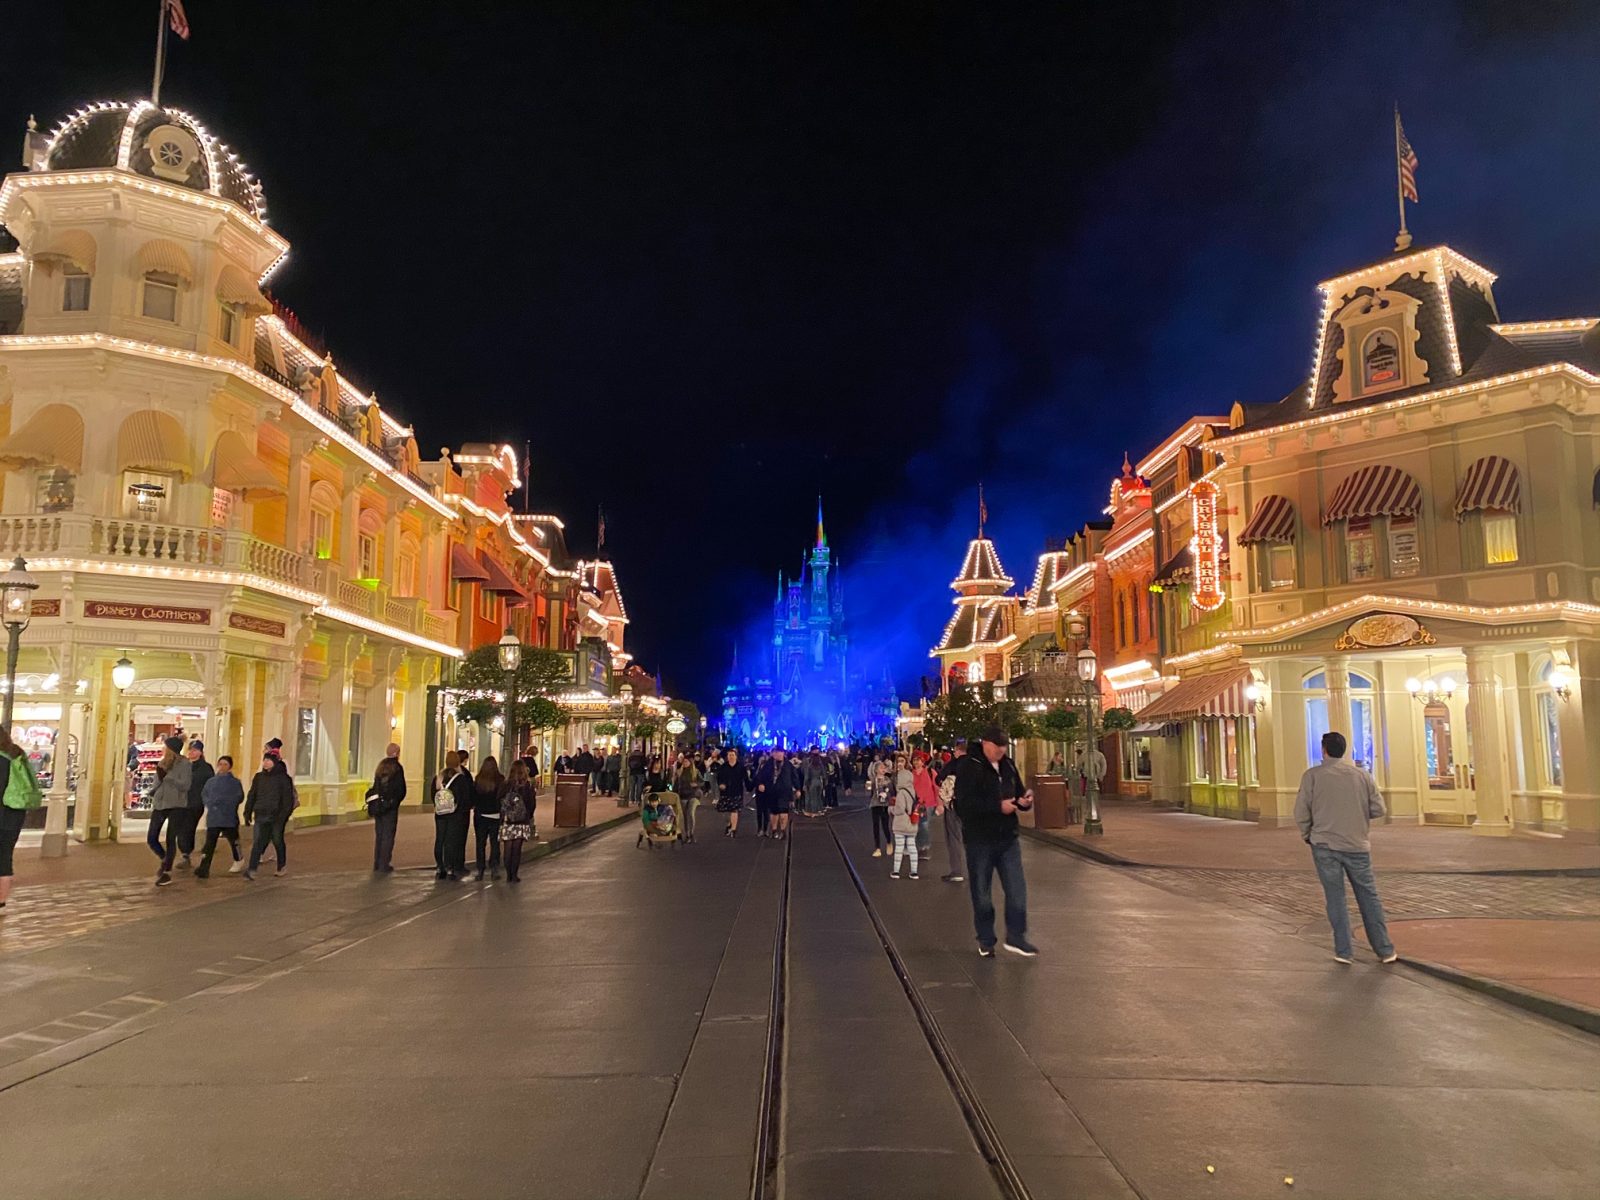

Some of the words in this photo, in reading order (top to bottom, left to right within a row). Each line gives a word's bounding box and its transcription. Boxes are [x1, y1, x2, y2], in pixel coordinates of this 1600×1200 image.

[1198, 499, 1212, 553] CRYSTAL
[1201, 561, 1214, 592] ARTS
[578, 703, 588, 711] OF
